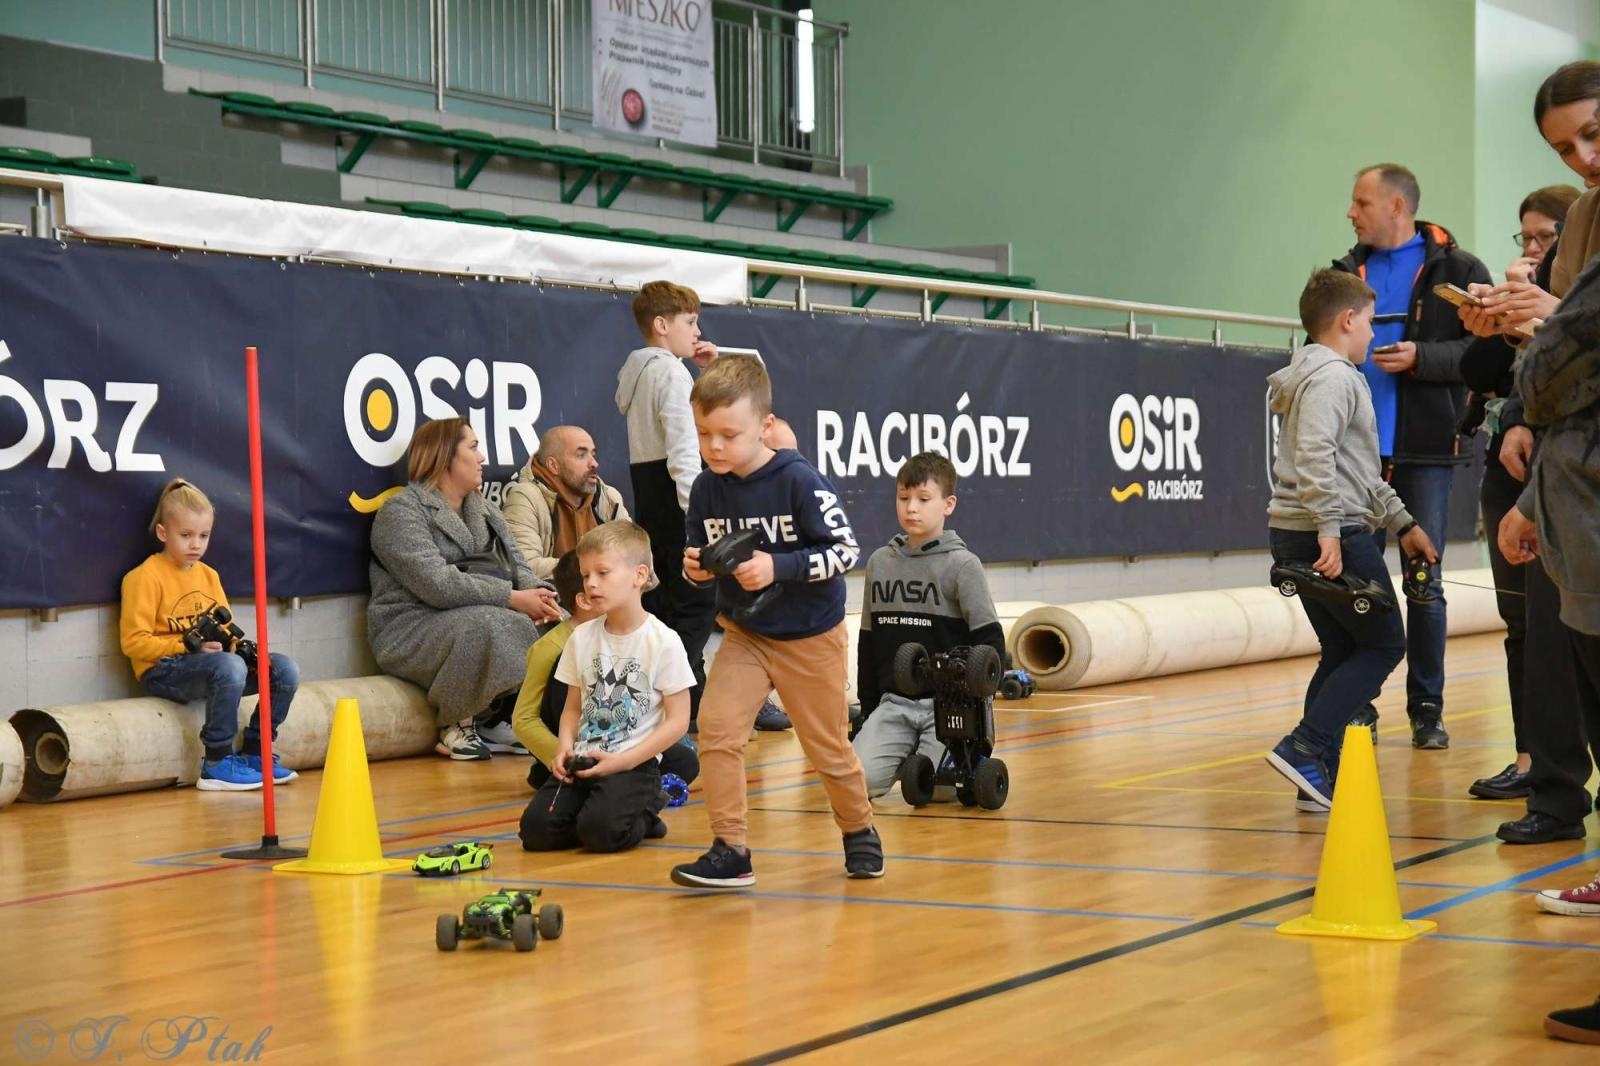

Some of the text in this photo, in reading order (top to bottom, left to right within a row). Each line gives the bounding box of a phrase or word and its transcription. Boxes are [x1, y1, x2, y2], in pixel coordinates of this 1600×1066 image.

[816, 391, 1032, 478] RACIBÓRZ
[1147, 473, 1204, 500] RACIBÓRZ
[871, 579, 941, 606] NASA
[878, 616, 932, 628] SPACE MISSION
